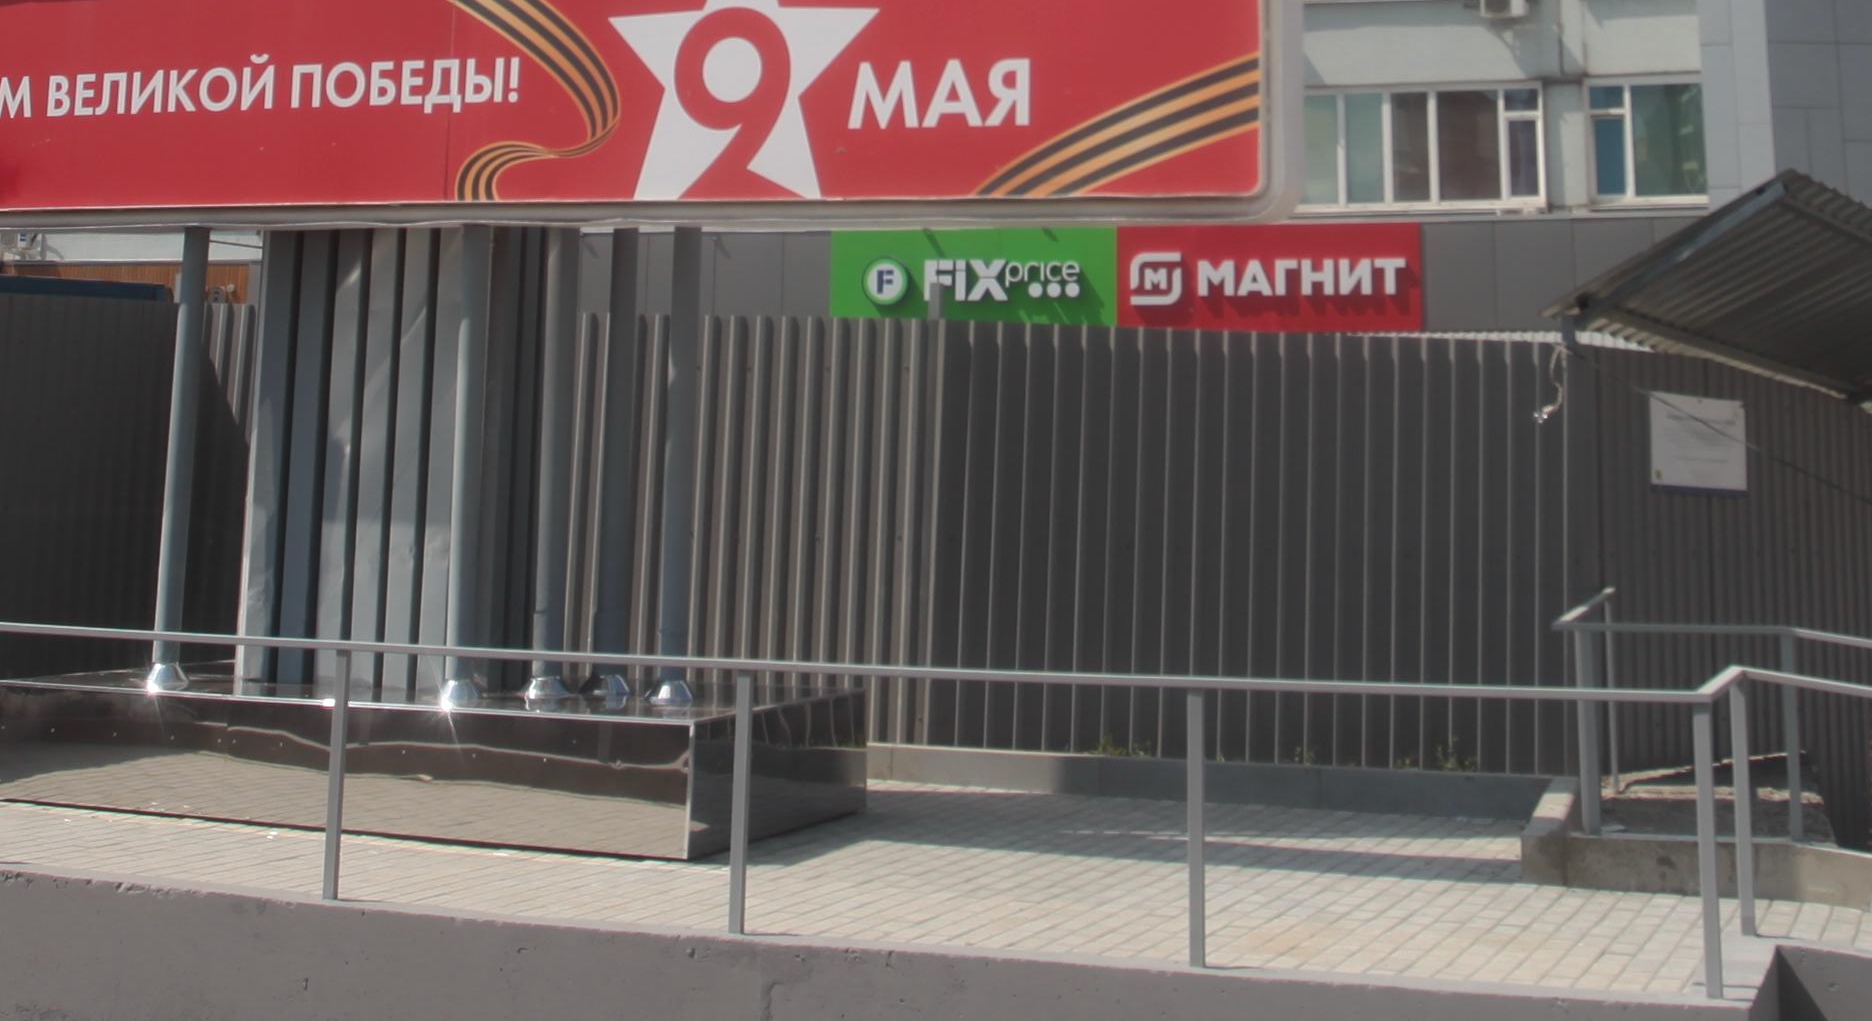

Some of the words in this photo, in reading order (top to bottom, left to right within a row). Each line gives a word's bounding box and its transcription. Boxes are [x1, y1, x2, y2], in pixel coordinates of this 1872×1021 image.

[46, 54, 275, 119] ВЕЛИКОЙ
[291, 57, 521, 114] ПОБЕДЫ!
[674, 6, 792, 199] 9
[847, 58, 1032, 130] МАЯ
[1004, 260, 1080, 288] price
[1197, 258, 1406, 297] МАГНИТ
